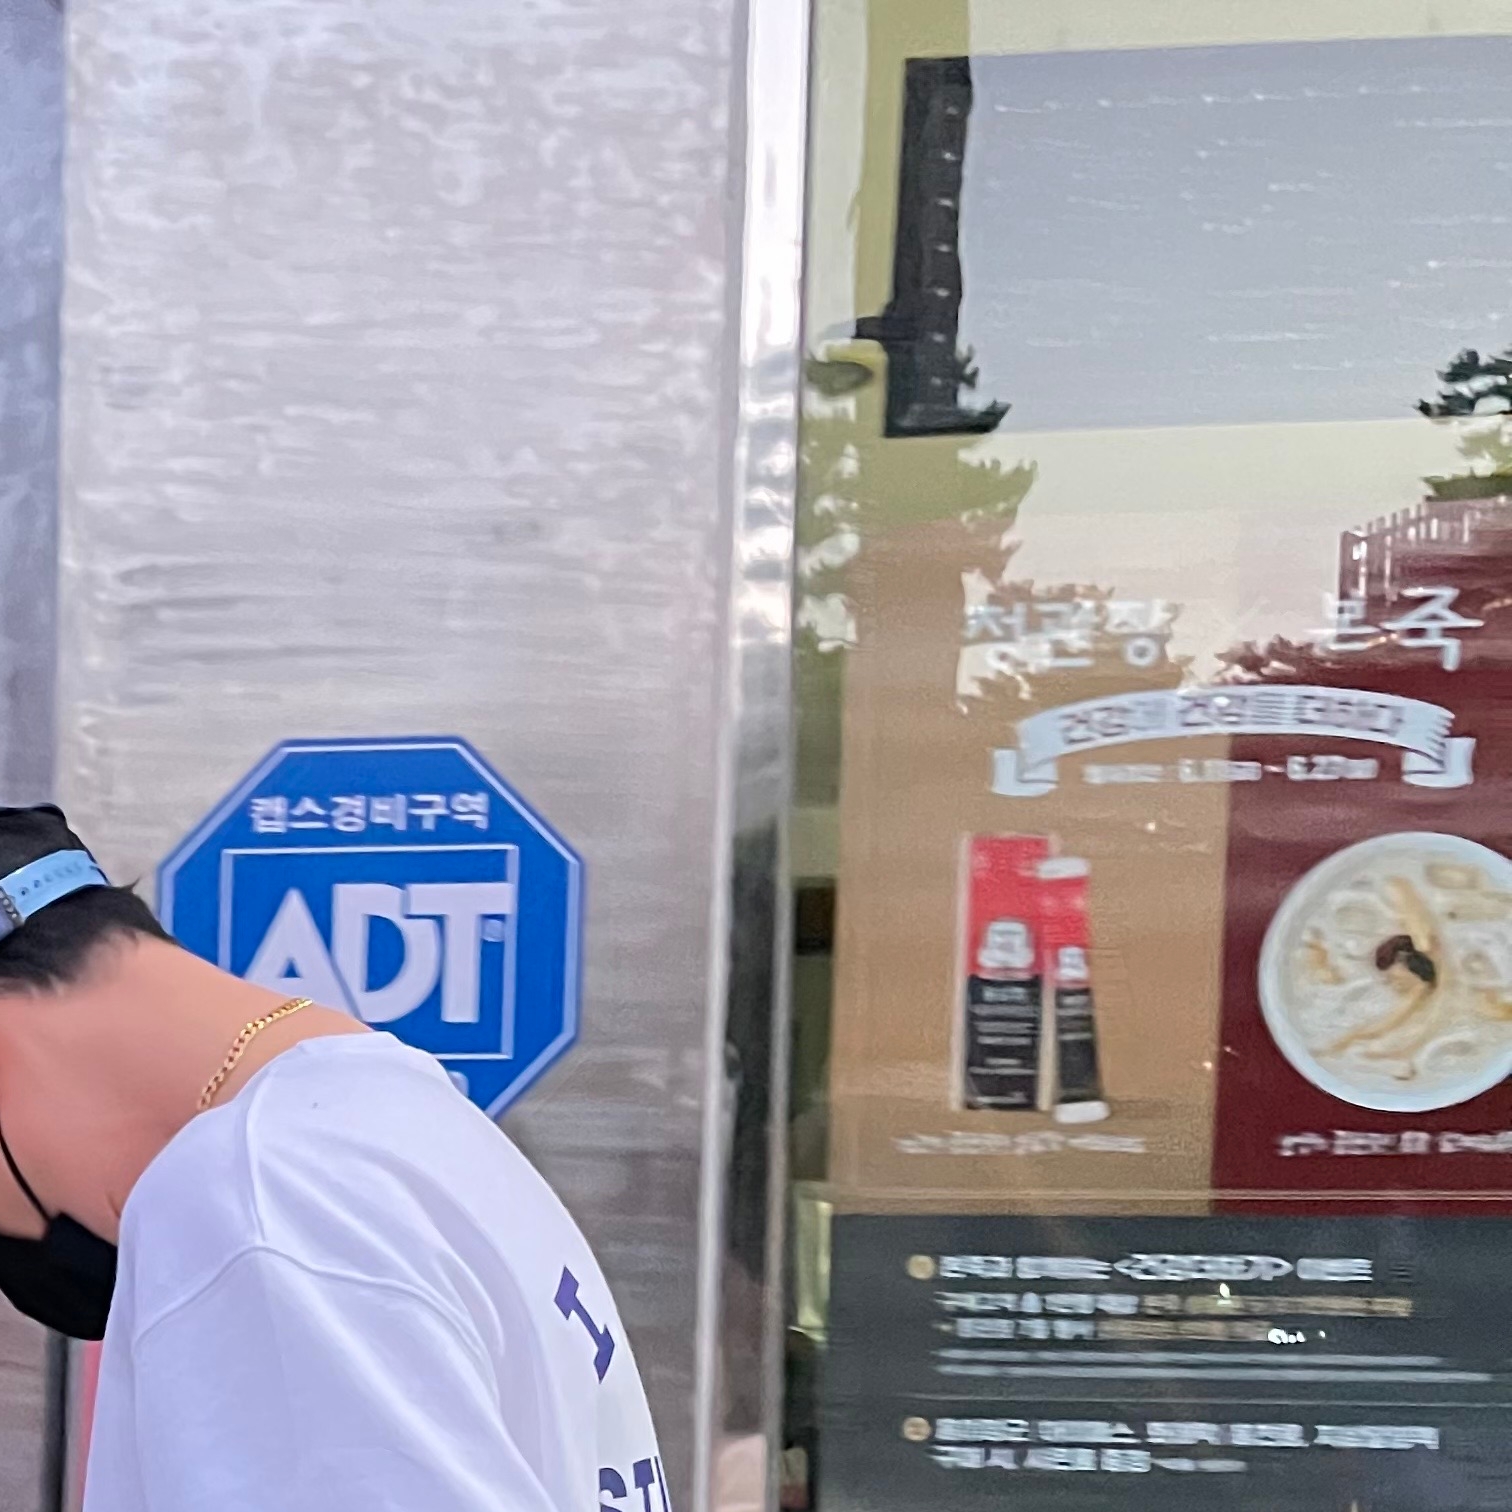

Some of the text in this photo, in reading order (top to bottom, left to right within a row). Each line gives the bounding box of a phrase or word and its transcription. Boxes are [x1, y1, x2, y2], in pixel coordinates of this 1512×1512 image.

[1304, 586, 1485, 672] 본죽
[248, 791, 490, 834] 캡스경비구역
[244, 882, 514, 1024] ADT
